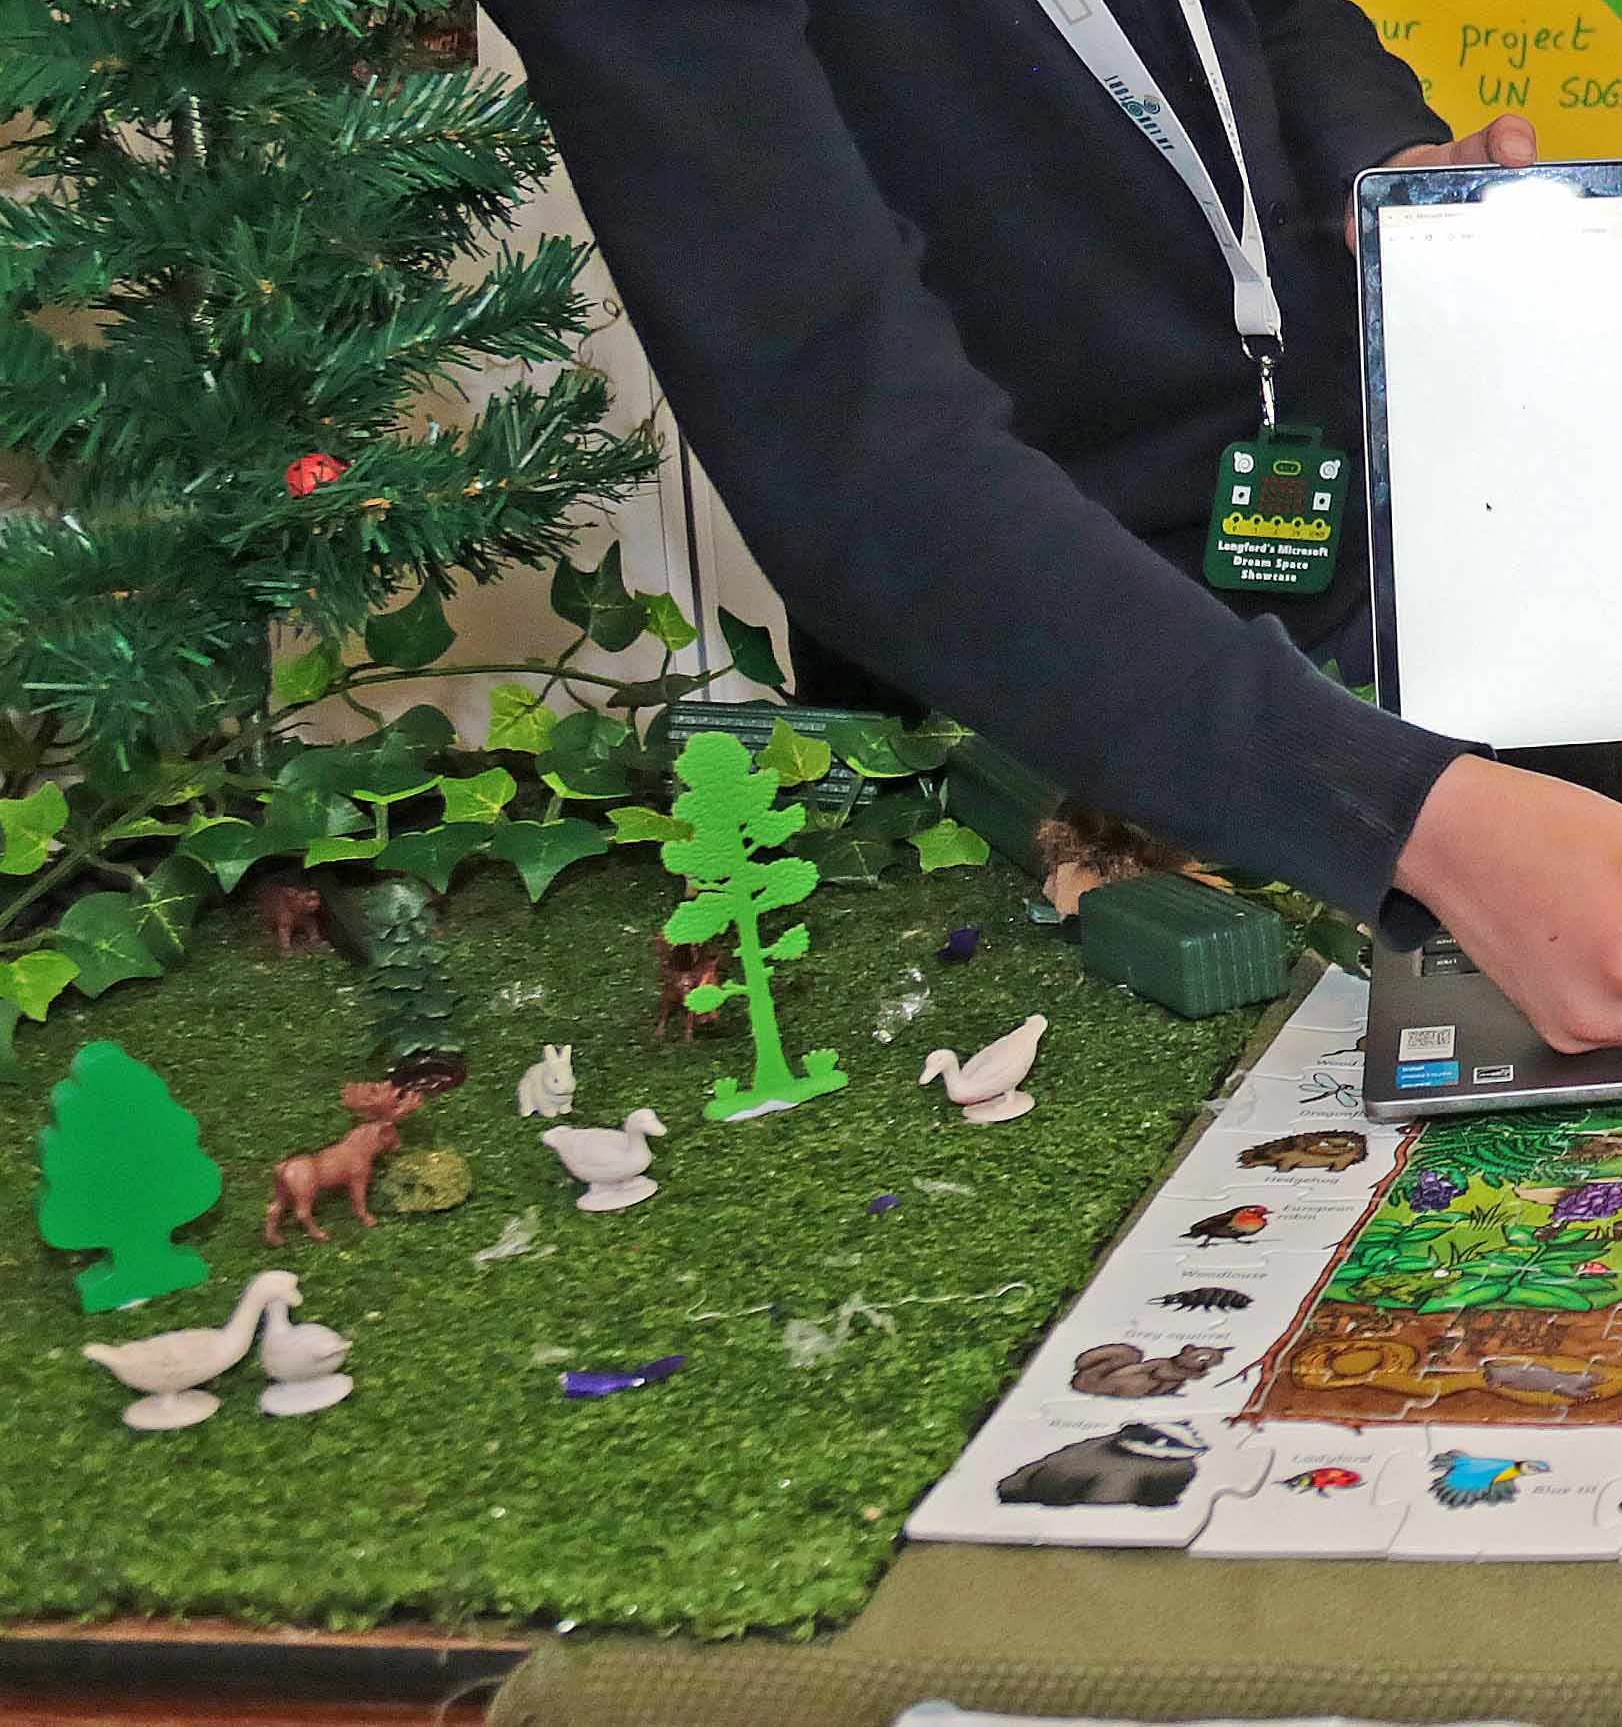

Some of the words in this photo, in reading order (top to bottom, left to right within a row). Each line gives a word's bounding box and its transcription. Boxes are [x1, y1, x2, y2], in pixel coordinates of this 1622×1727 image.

[1460, 17, 1598, 68] project
[1479, 79, 1530, 106] UN
[1233, 556, 1271, 568] Dream
[1275, 558, 1309, 571] Space
[1241, 570, 1297, 582] Showcase
